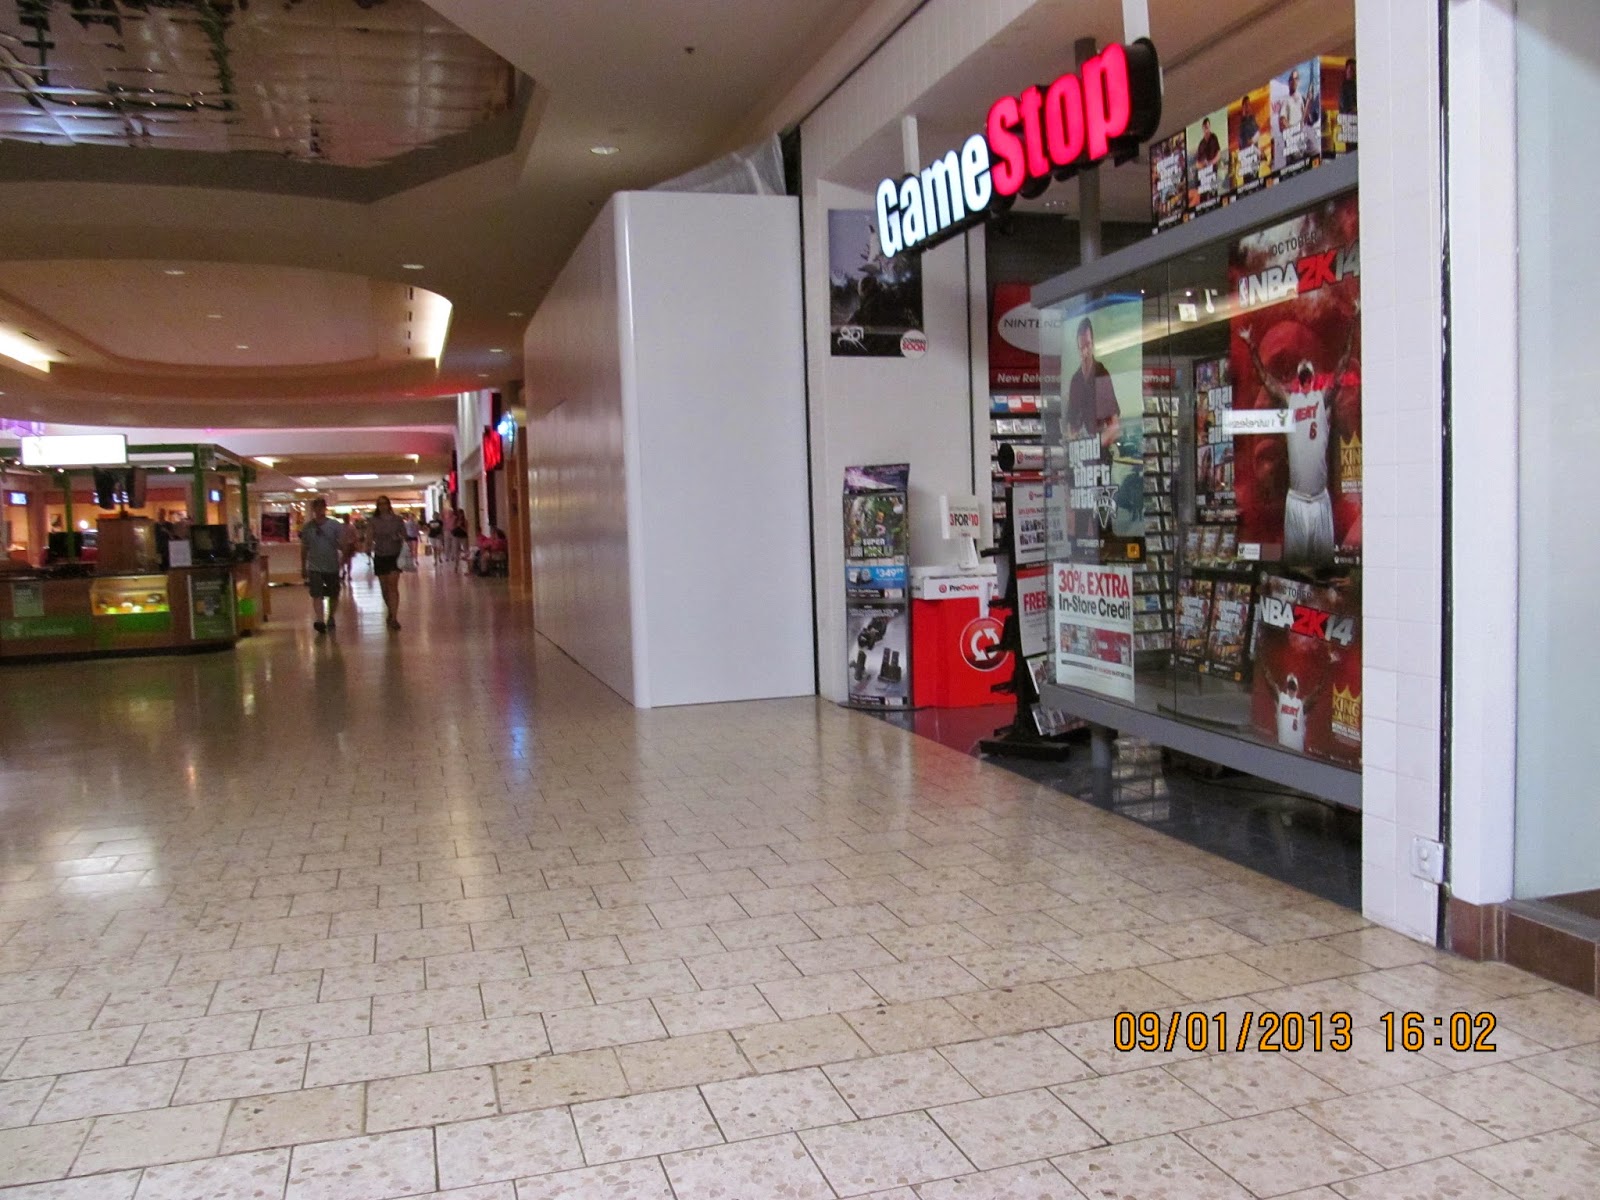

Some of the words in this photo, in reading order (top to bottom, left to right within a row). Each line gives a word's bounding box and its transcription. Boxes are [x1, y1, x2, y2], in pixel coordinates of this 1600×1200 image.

[876, 43, 1131, 258] GameStop
[1004, 318, 1063, 328] NINTEND
[902, 342, 926, 352] SOON
[997, 372, 1020, 383] New
[1143, 375, 1170, 383] ames
[1309, 421, 1318, 440] 6
[1340, 448, 1361, 466] KIN
[1073, 463, 1110, 487] theft
[1058, 569, 1086, 595] 30%
[1087, 572, 1131, 600] EXTRA
[1023, 592, 1047, 612] FREE
[1059, 593, 1098, 615] In-Store
[1098, 598, 1131, 620] Credit
[1260, 595, 1295, 629] NBA
[1332, 695, 1360, 718] KING
